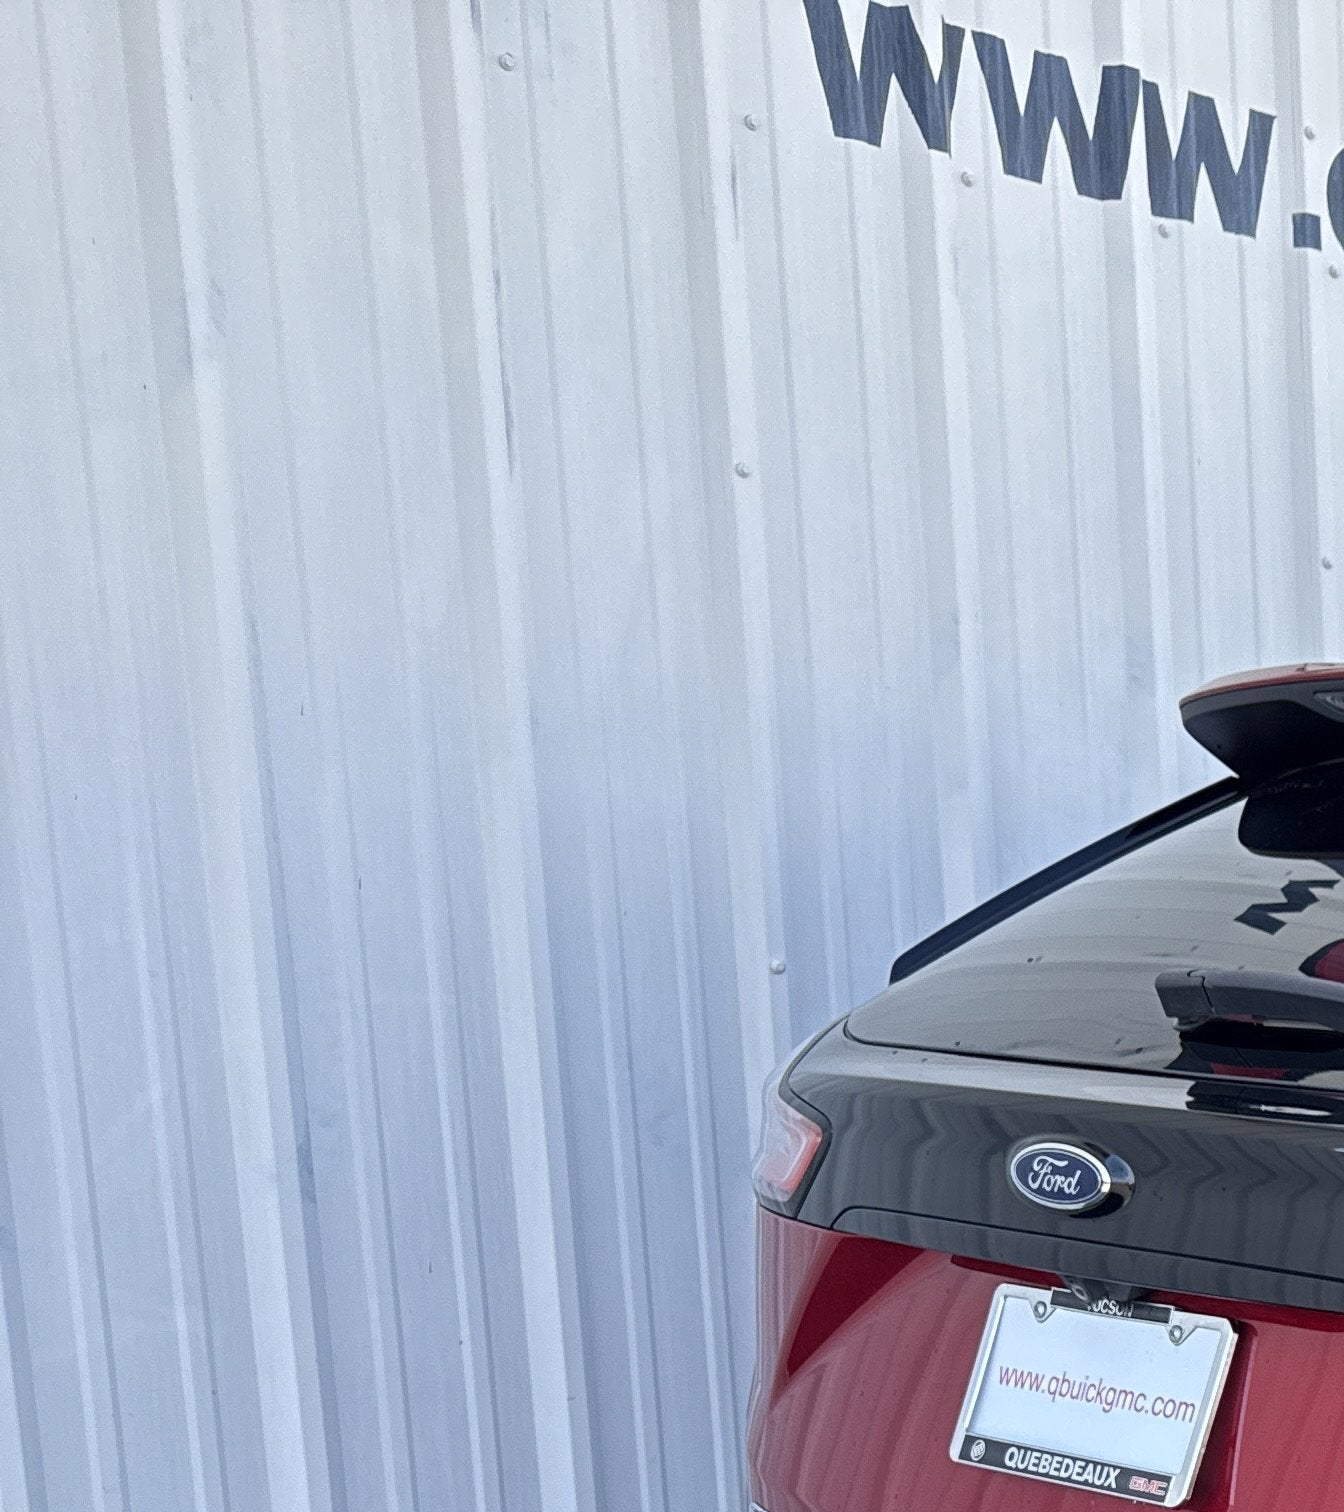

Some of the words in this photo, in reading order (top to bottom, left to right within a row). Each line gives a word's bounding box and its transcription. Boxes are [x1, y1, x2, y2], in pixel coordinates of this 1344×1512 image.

[1028, 1155, 1081, 1195] Ford
[1087, 1297, 1135, 1318] UCSON
[999, 1365, 1196, 1424] www.qbuickgmc.com
[1004, 1446, 1121, 1489] QUEBEDEAUX
[1129, 1475, 1168, 1496] GMC
